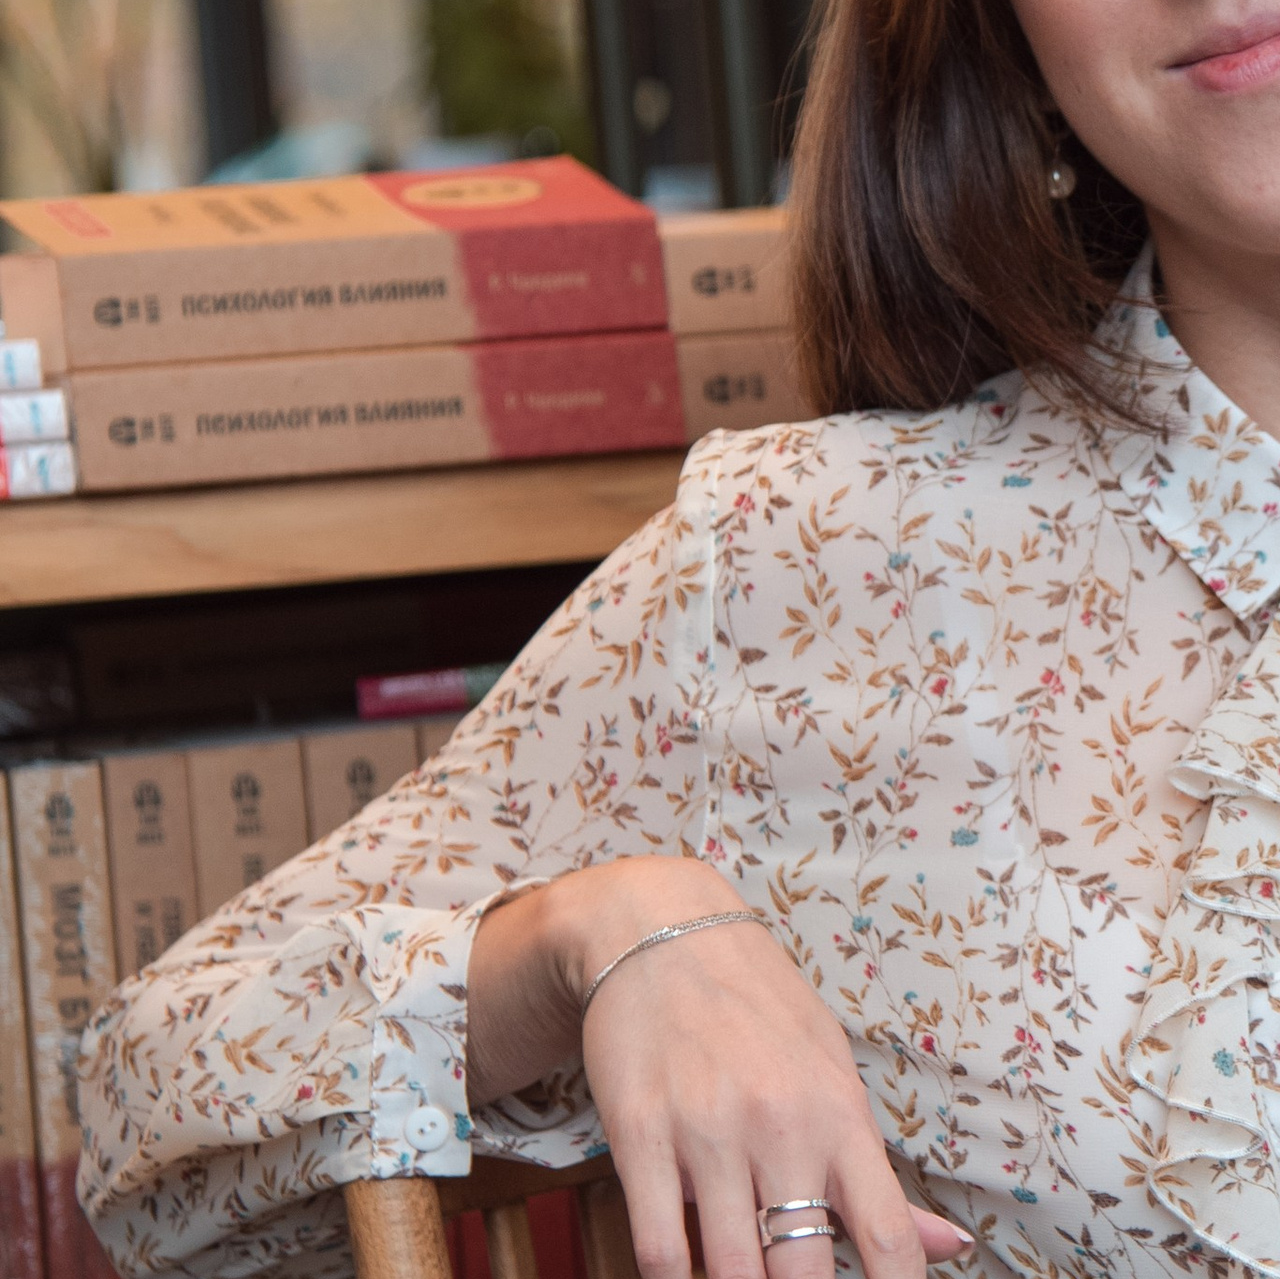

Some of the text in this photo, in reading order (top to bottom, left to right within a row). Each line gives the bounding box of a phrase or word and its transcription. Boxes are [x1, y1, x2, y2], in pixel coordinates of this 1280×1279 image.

[181, 283, 333, 318] ПСИХОЛОГИЯ
[339, 275, 448, 306] ВЛИЯНИЯ
[195, 403, 349, 437] ПСИХОЛОГИЯ
[353, 395, 464, 425] ВЛИЯНИЯ
